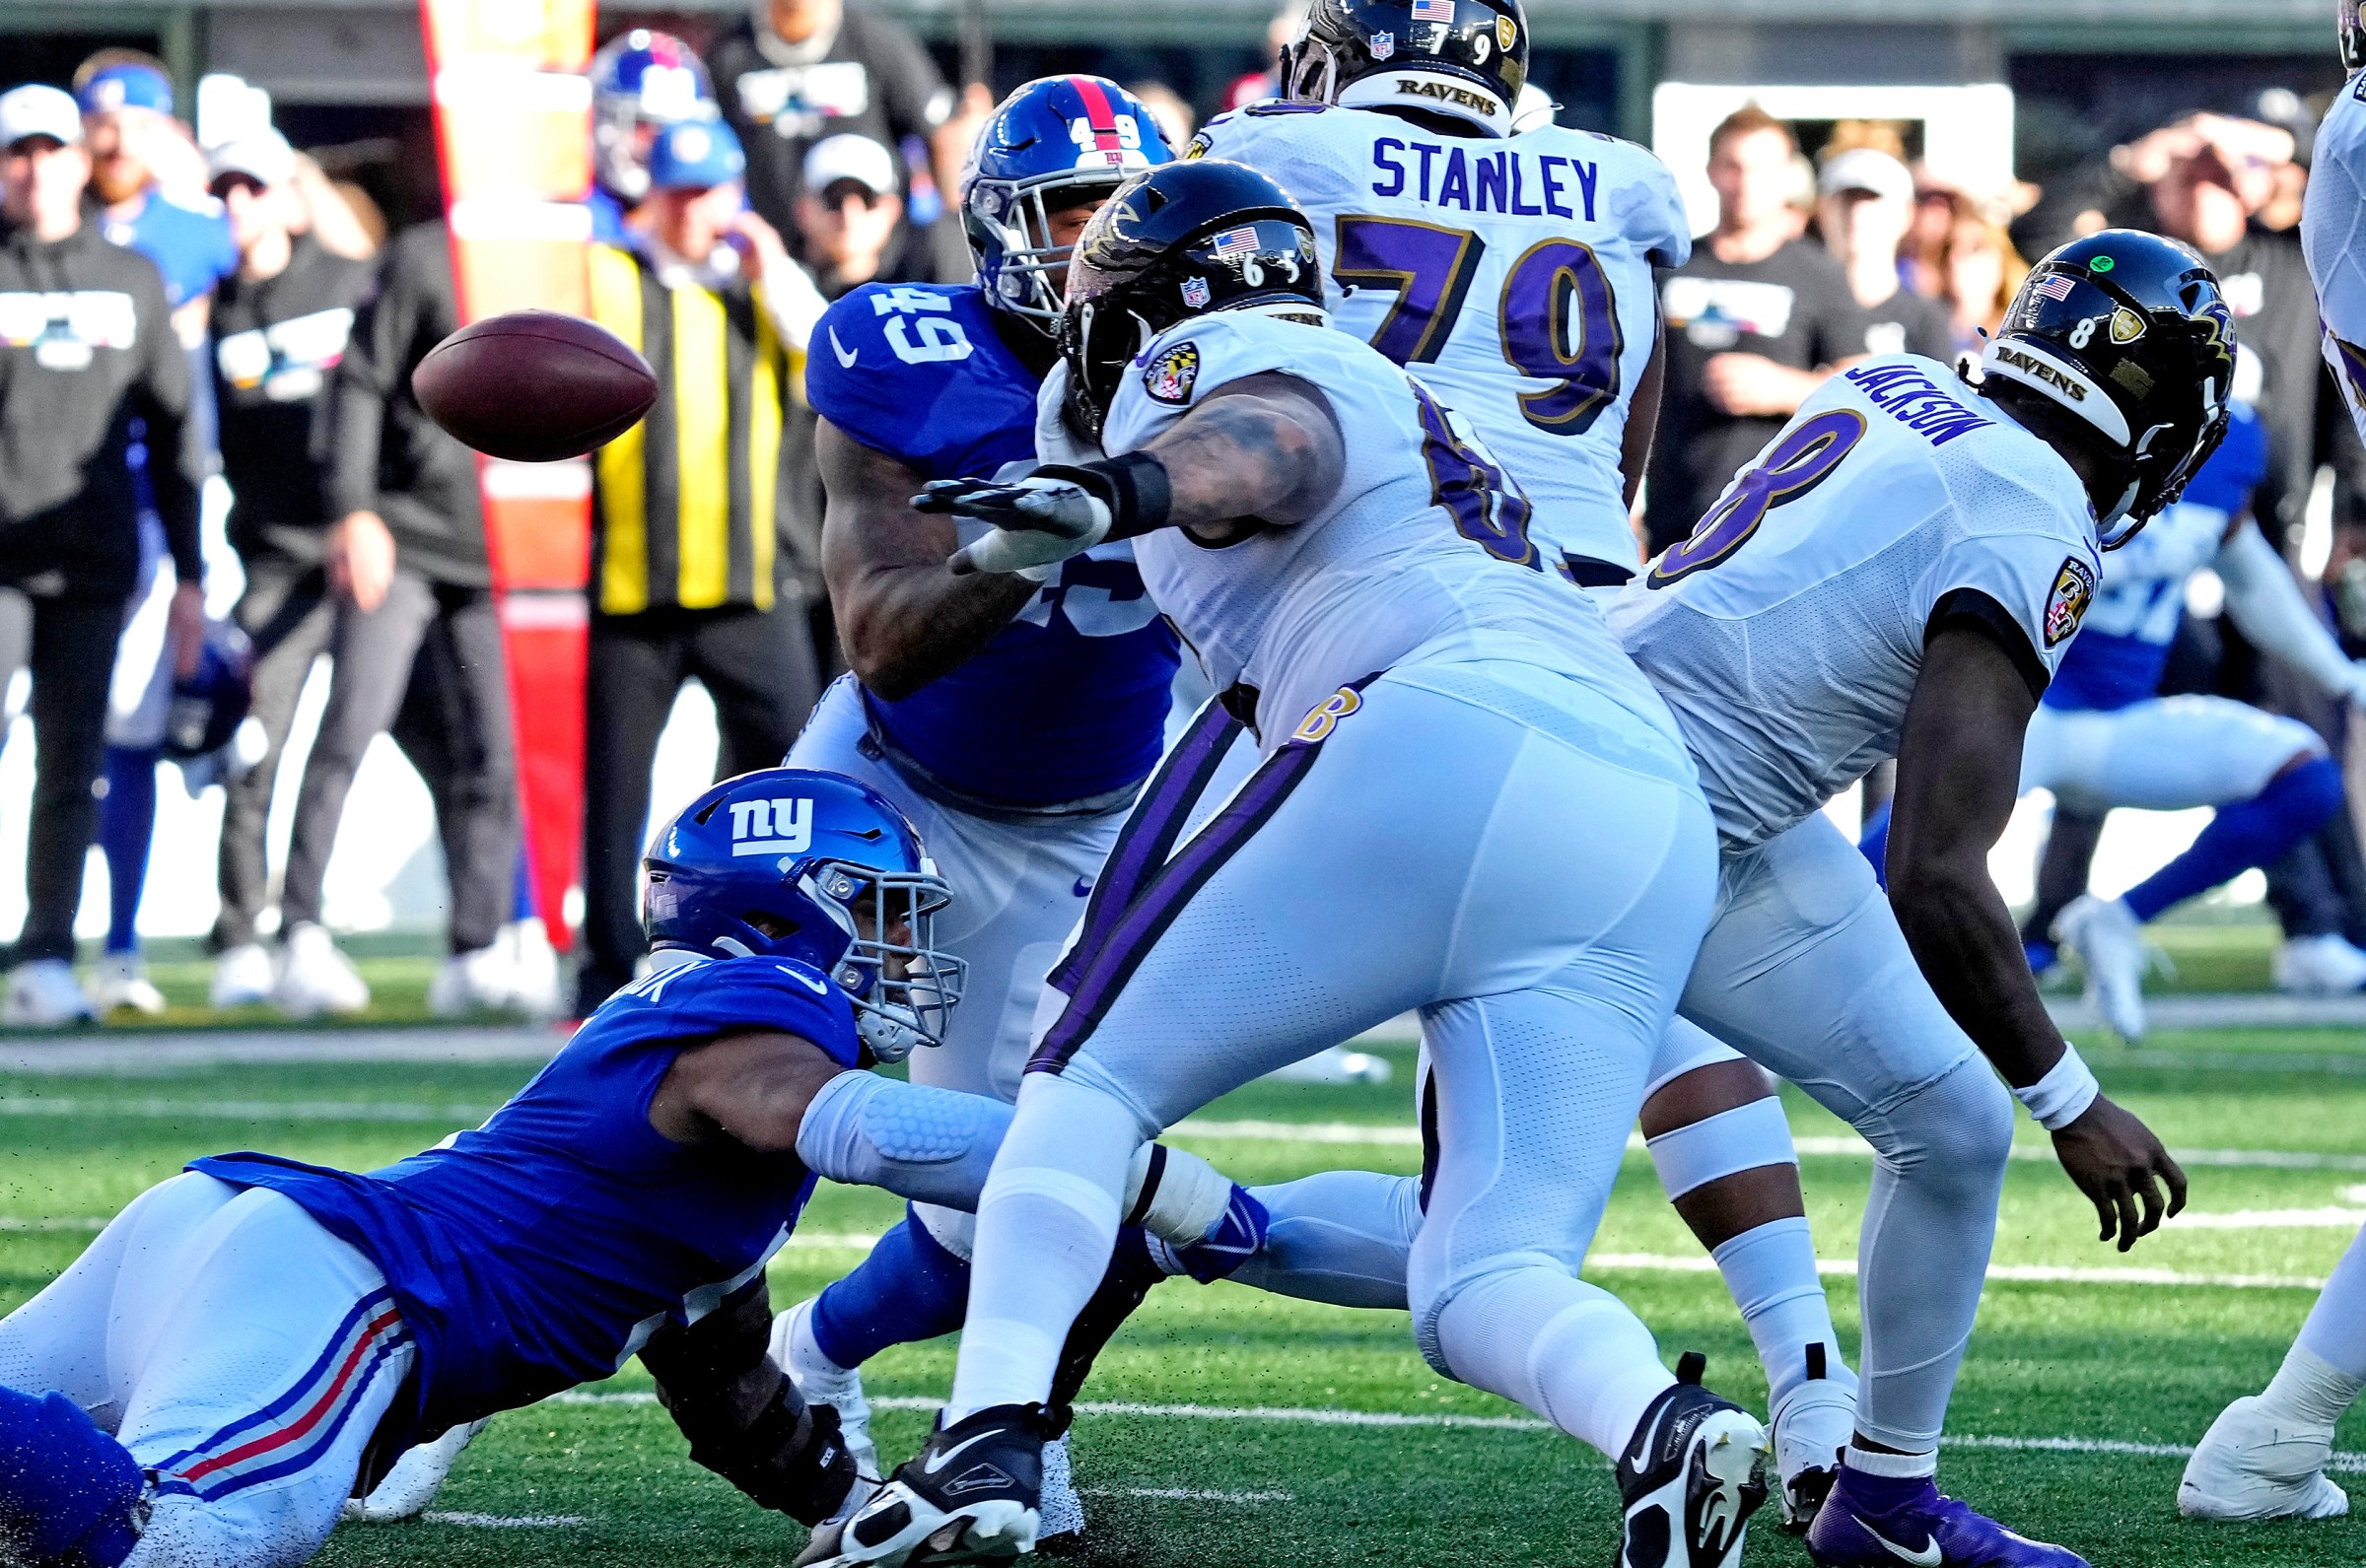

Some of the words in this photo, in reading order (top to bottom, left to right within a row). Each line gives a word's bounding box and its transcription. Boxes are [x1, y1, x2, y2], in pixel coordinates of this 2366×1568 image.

[1429, 22, 1492, 65] 79
[1395, 79, 1497, 117] RAVENS
[1070, 113, 1142, 153] 49
[1372, 136, 1597, 222] STANLEY
[1242, 251, 1300, 288] 65
[870, 287, 975, 365] 49
[1331, 213, 1625, 436] 79
[2068, 317, 2097, 350] 8
[1995, 346, 2089, 402] RAVENS
[1844, 365, 1998, 447] JACKSON
[1646, 407, 1868, 590] 8
[1290, 686, 1361, 743] B
[729, 798, 814, 857] ny
